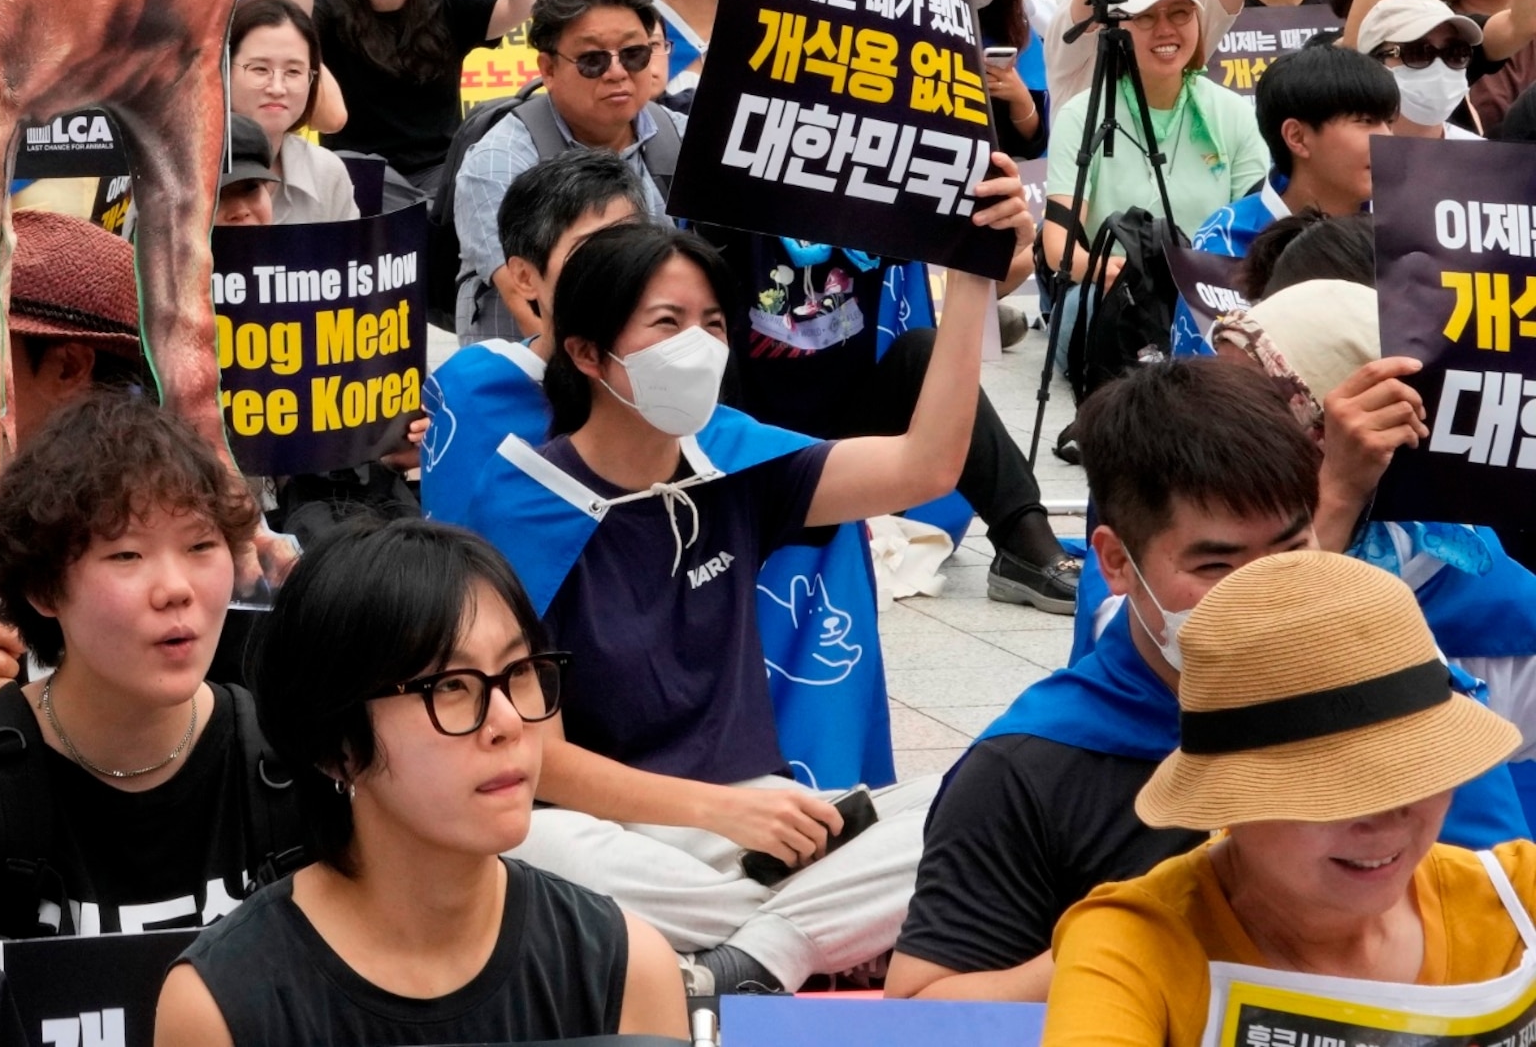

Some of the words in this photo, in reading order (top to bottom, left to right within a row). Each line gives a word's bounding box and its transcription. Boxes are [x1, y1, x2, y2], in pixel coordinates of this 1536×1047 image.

[749, 8, 898, 105] 개식용
[910, 40, 989, 126] 없는
[1218, 30, 1276, 53] 이제는
[53, 116, 113, 142] LCA
[721, 93, 991, 217] 대한민국!
[1435, 199, 1536, 257] 이제
[253, 265, 341, 303] Time
[348, 260, 373, 298] is
[378, 251, 417, 292] Now
[215, 314, 302, 375] Dog
[316, 299, 410, 366] Meat
[311, 367, 420, 432] Korea
